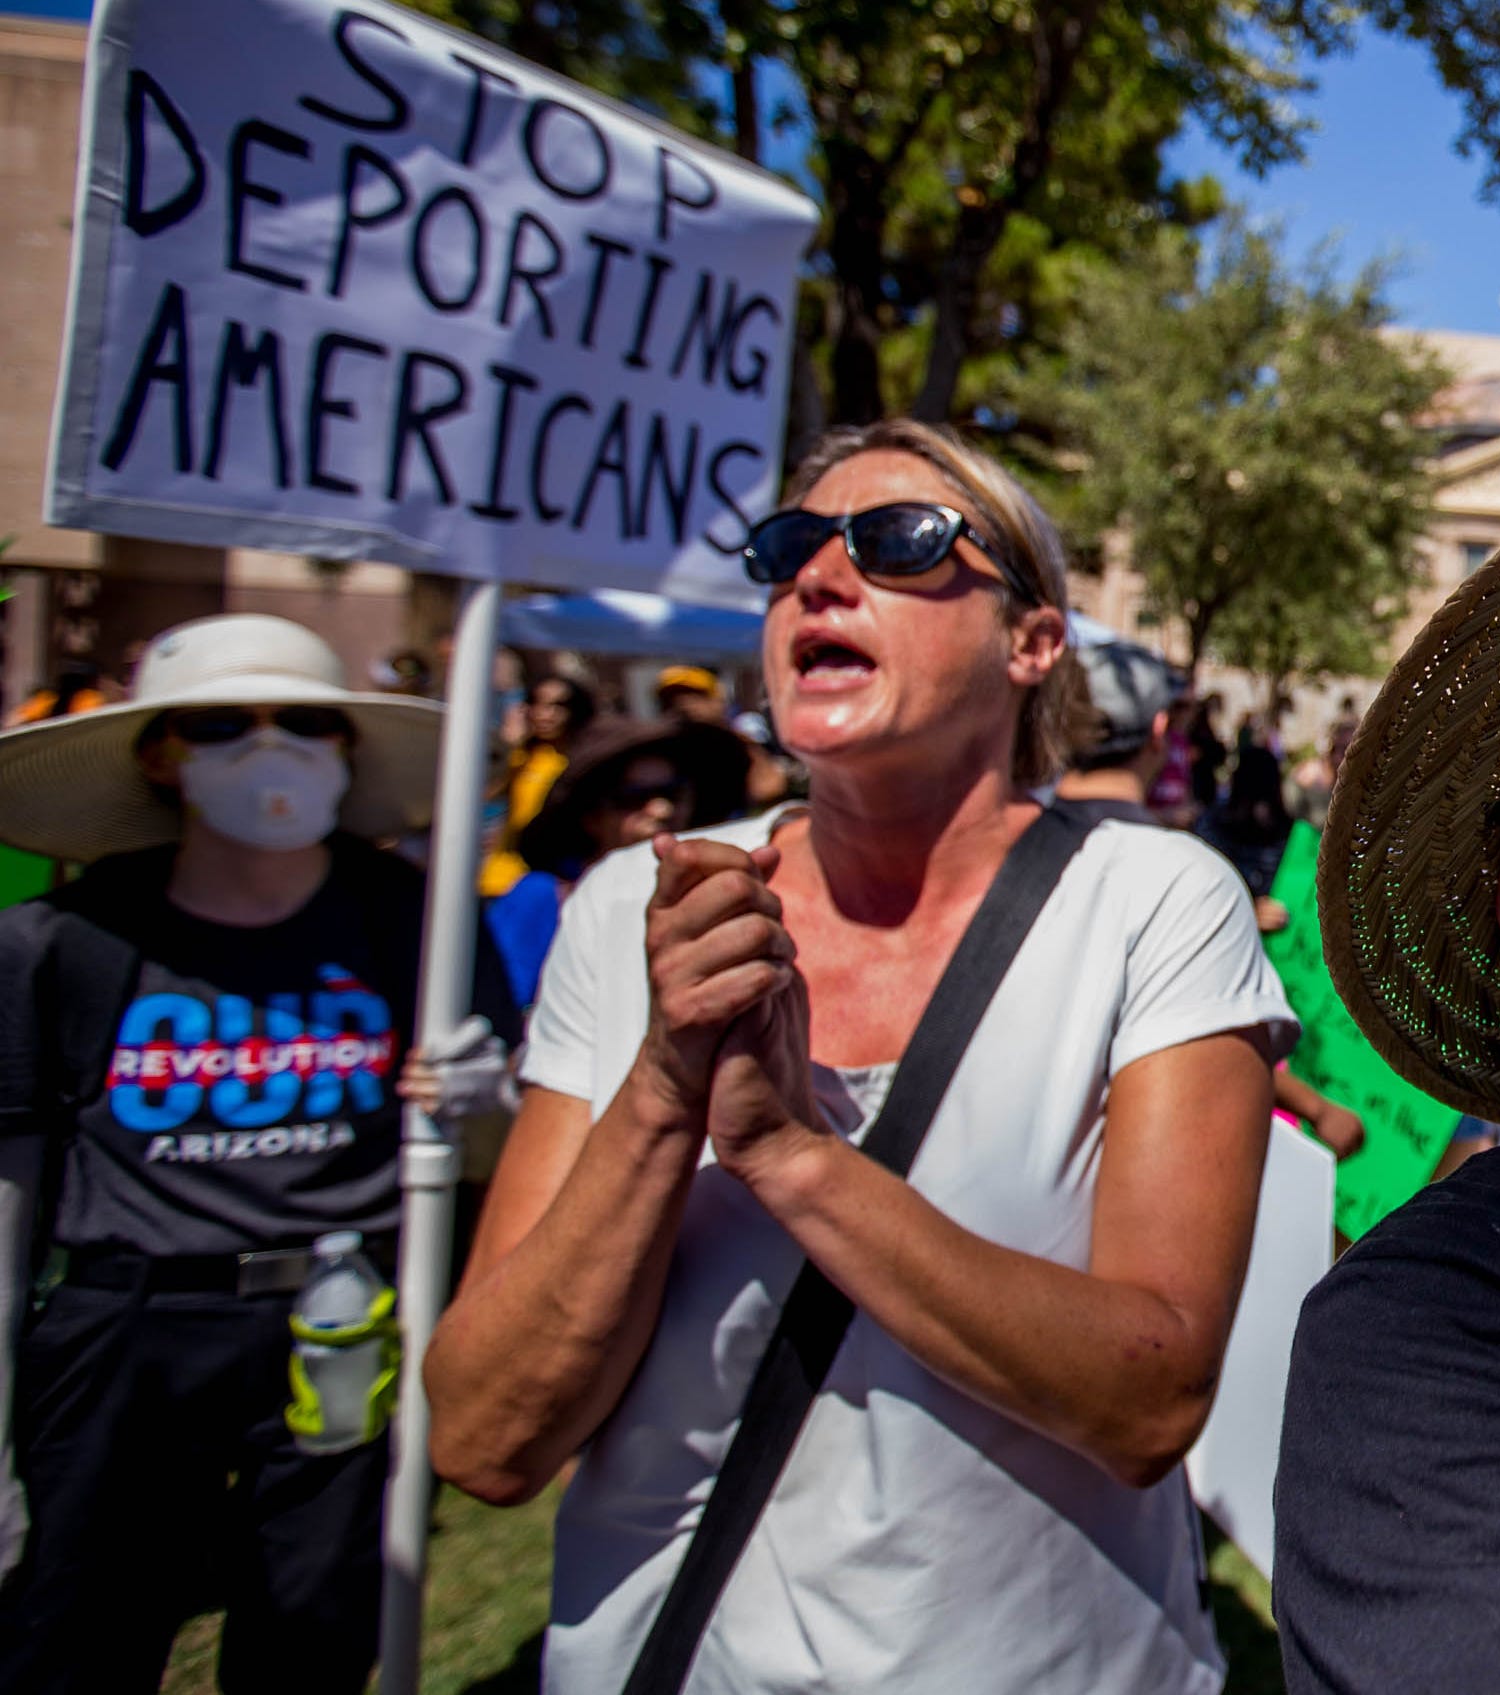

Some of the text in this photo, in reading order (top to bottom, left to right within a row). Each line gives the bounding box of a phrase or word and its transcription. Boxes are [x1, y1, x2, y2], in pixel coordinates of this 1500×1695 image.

[123, 67, 782, 398] DEPORTING
[297, 8, 721, 241] STOP
[99, 282, 764, 558] AMERICANS
[113, 1036, 392, 1077] REVOLUTION
[145, 1122, 355, 1162] ARIZONA
